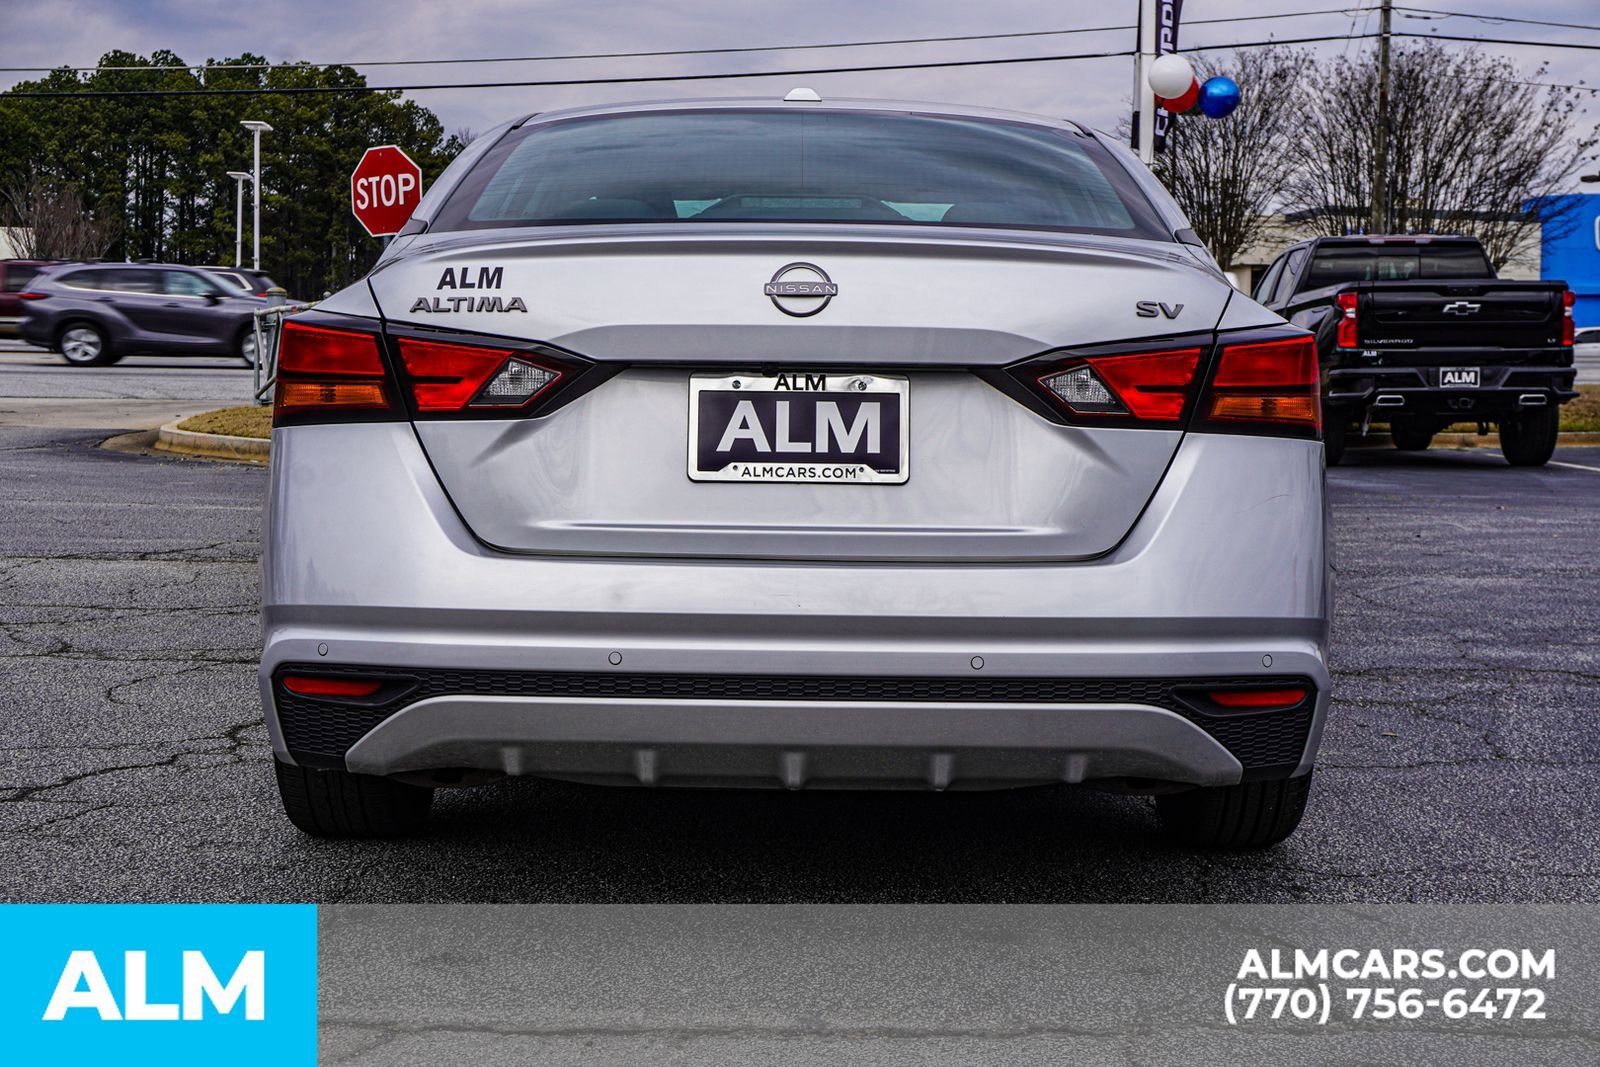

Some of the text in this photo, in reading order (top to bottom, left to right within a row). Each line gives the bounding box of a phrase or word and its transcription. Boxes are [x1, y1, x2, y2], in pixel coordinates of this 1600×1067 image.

[356, 173, 415, 210] STOP
[437, 267, 504, 290] ALM
[766, 283, 837, 294] NISSAN
[410, 297, 528, 313] ALTIMA
[1136, 301, 1184, 319] SV
[774, 374, 827, 391] ALM
[1443, 371, 1475, 383] ALM
[716, 400, 880, 454] ALM
[741, 466, 857, 479] ALMCARS.COM
